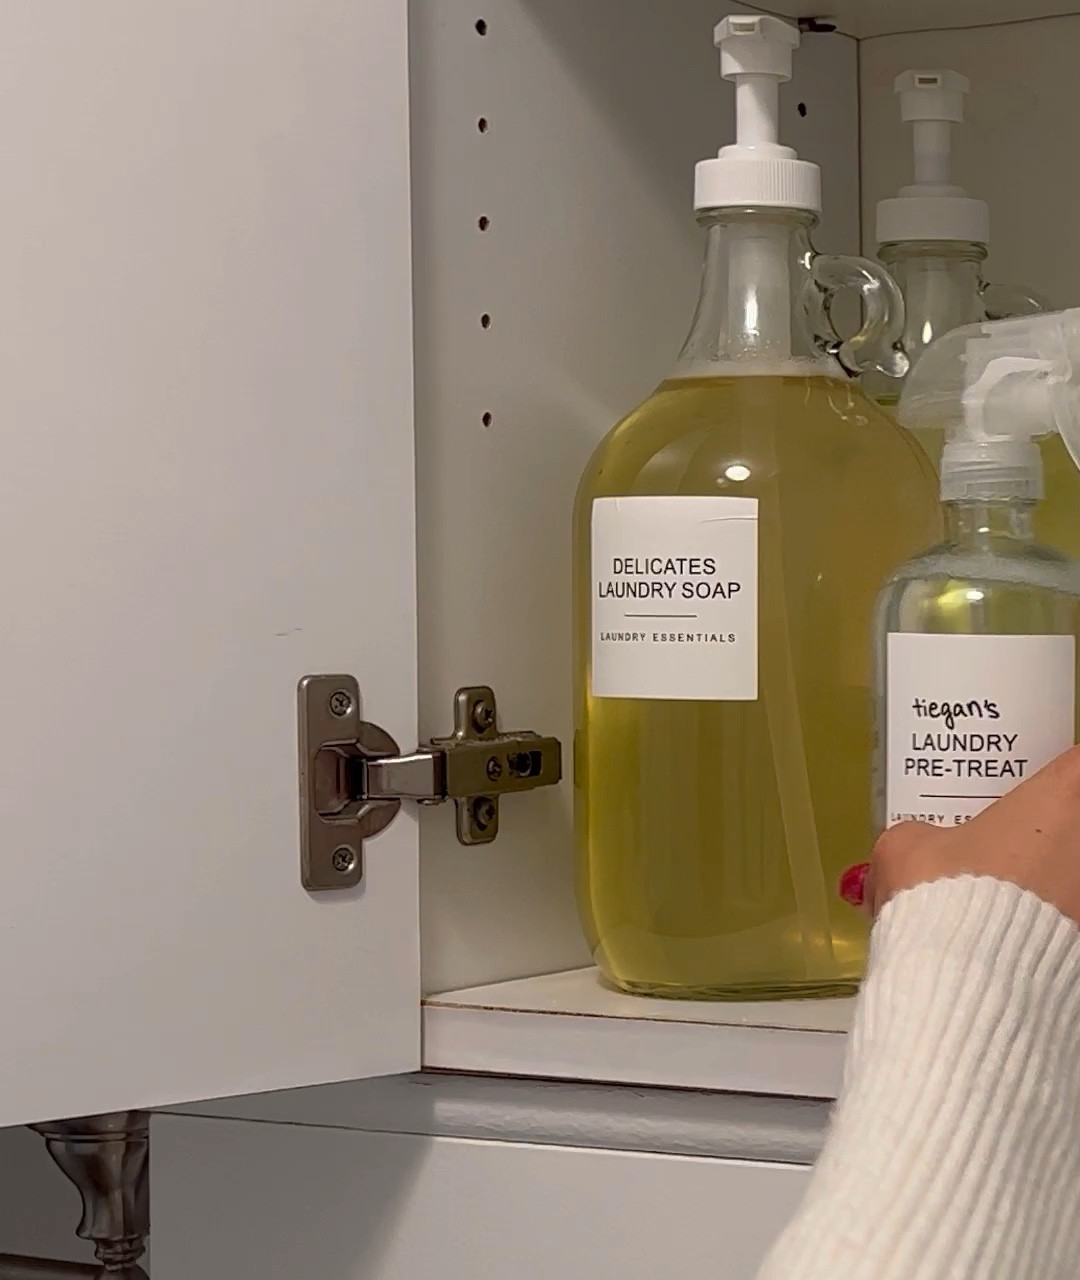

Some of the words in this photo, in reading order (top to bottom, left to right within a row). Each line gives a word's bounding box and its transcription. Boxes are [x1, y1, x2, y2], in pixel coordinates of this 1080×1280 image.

[613, 558, 716, 575] DELICATES
[599, 581, 677, 599] LAUNDRY
[681, 582, 741, 599] SOAP
[600, 632, 646, 642] LAUNDRY
[652, 633, 736, 643] ESSENTIALS
[912, 733, 1018, 752] LAUNDRY
[904, 758, 1028, 777] PRE-TREAT
